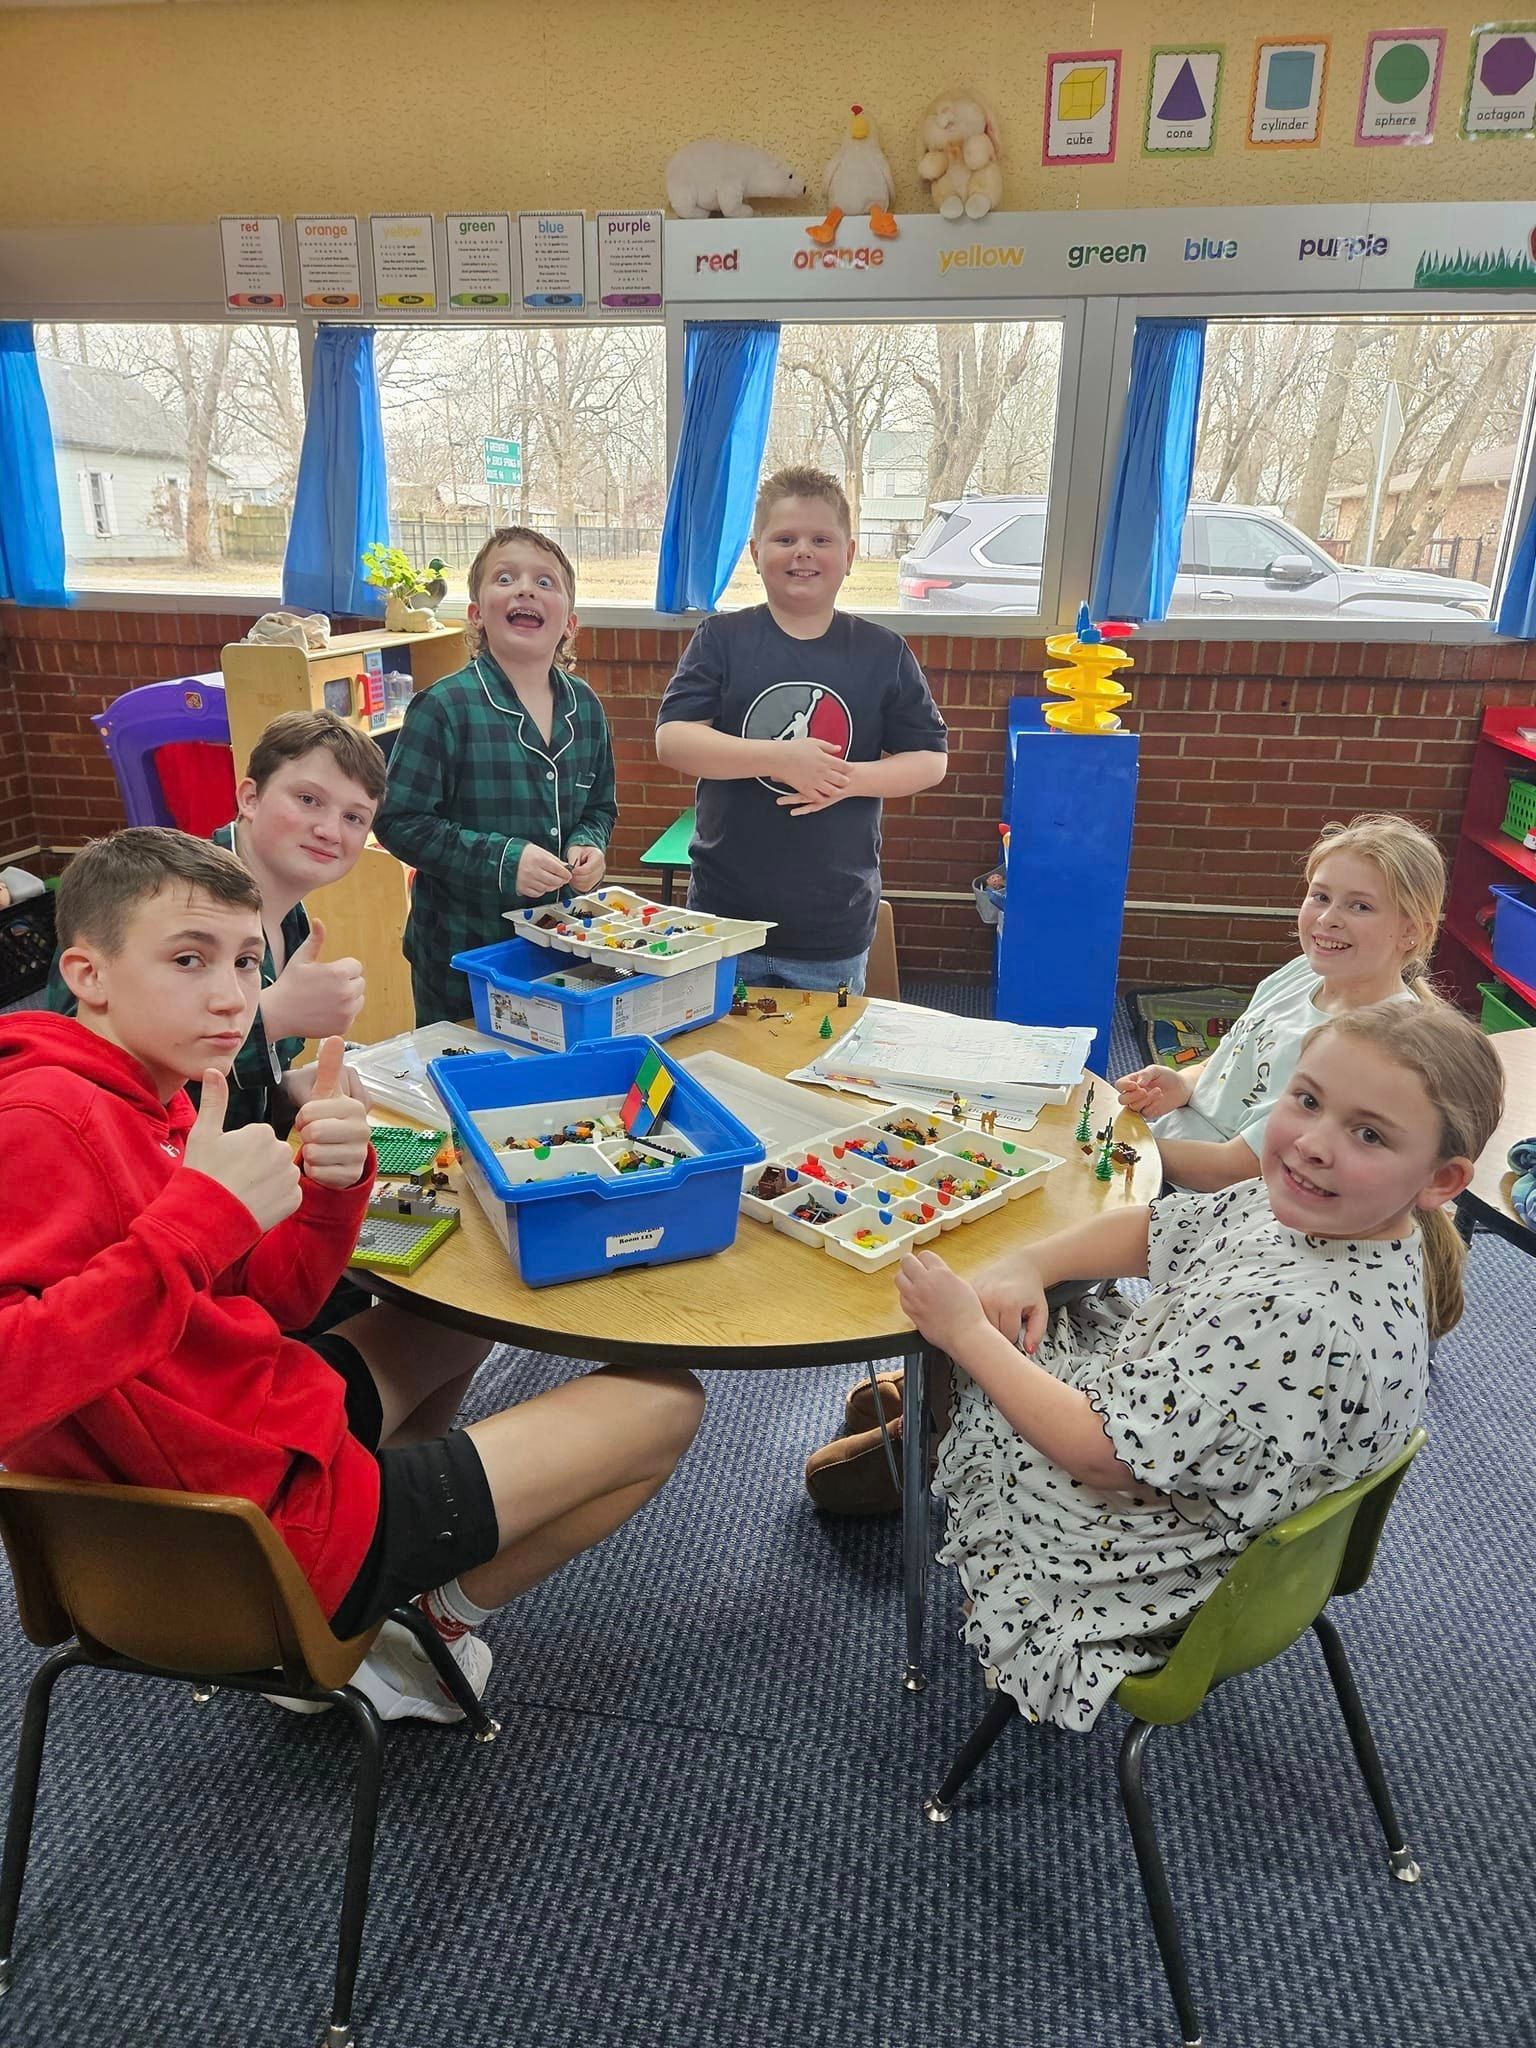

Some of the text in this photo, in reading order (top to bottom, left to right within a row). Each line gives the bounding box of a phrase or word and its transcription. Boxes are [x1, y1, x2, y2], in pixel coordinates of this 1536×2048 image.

[1375, 114, 1417, 128] sphere
[1477, 109, 1525, 122] octagon
[1261, 118, 1309, 131] cylinder
[1066, 132, 1093, 145] cube
[1166, 129, 1193, 138] cone
[241, 221, 259, 232] red
[304, 225, 348, 239] orange
[459, 221, 496, 235] green
[538, 220, 564, 233] blue
[608, 218, 651, 236] purple
[695, 234, 1388, 273] red orange yellow green blue purple
